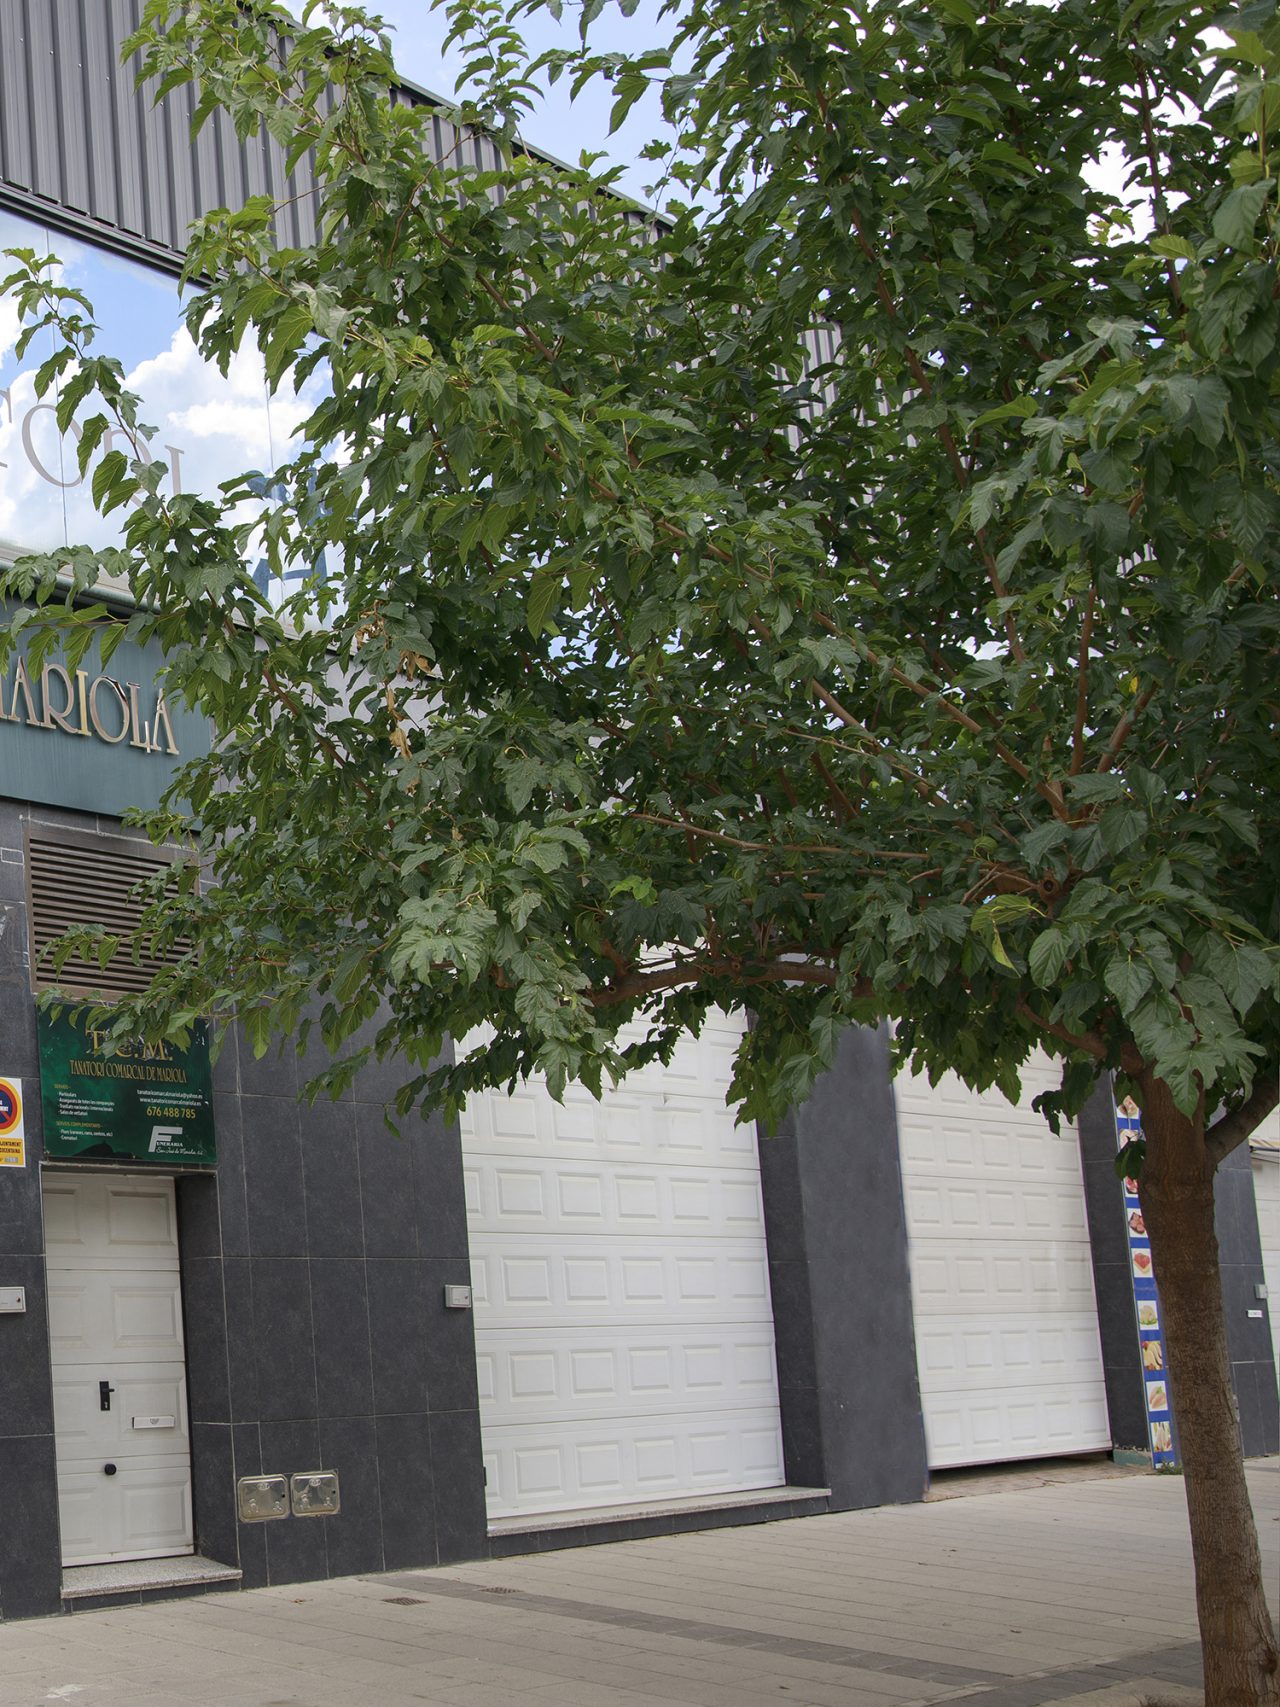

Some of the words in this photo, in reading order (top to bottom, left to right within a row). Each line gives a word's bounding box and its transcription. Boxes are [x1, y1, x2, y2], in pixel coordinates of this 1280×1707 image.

[70, 1060, 105, 1077] TANATORI
[106, 1062, 145, 1080] COMARCAL
[146, 1066, 156, 1081] DE
[157, 1067, 187, 1083] MARIOLA
[146, 1106, 161, 1116] 676
[164, 1107, 179, 1118] 488
[181, 1108, 196, 1118] 785
